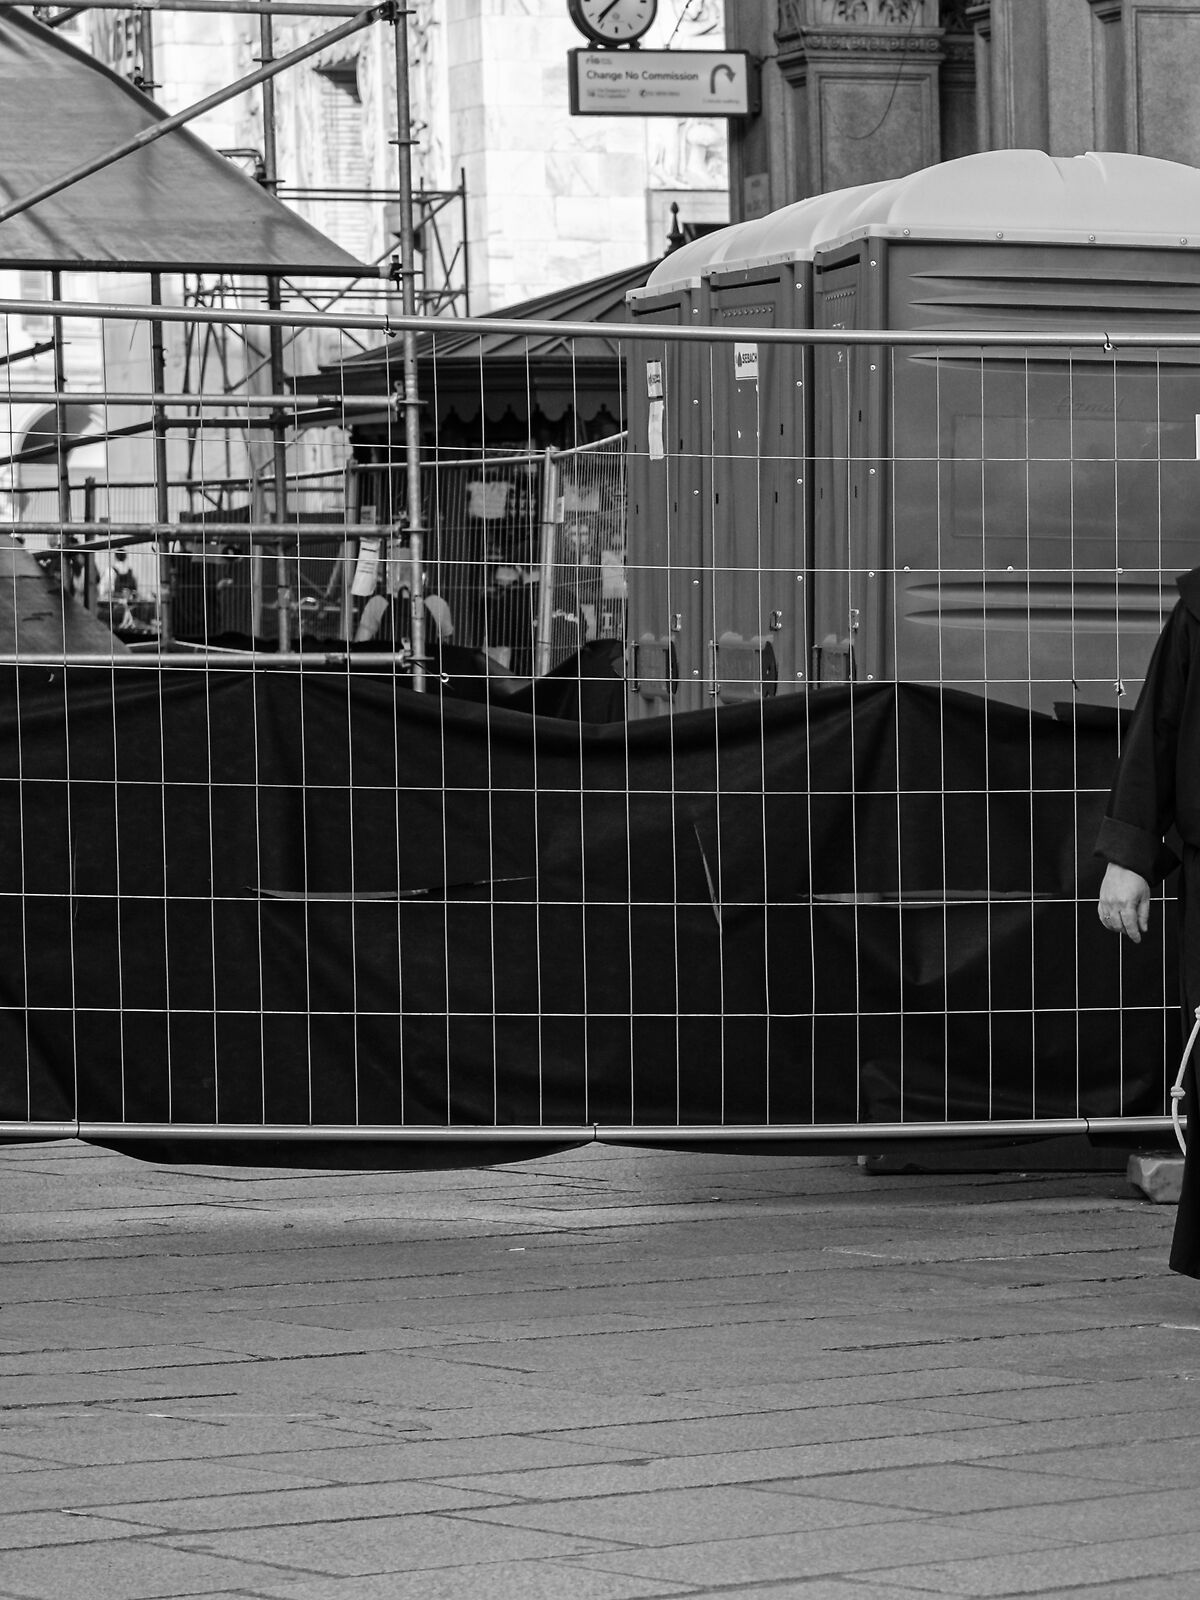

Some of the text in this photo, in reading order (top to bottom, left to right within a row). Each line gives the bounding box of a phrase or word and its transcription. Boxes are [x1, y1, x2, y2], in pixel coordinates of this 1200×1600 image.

[586, 70, 699, 81] Change No Commission
